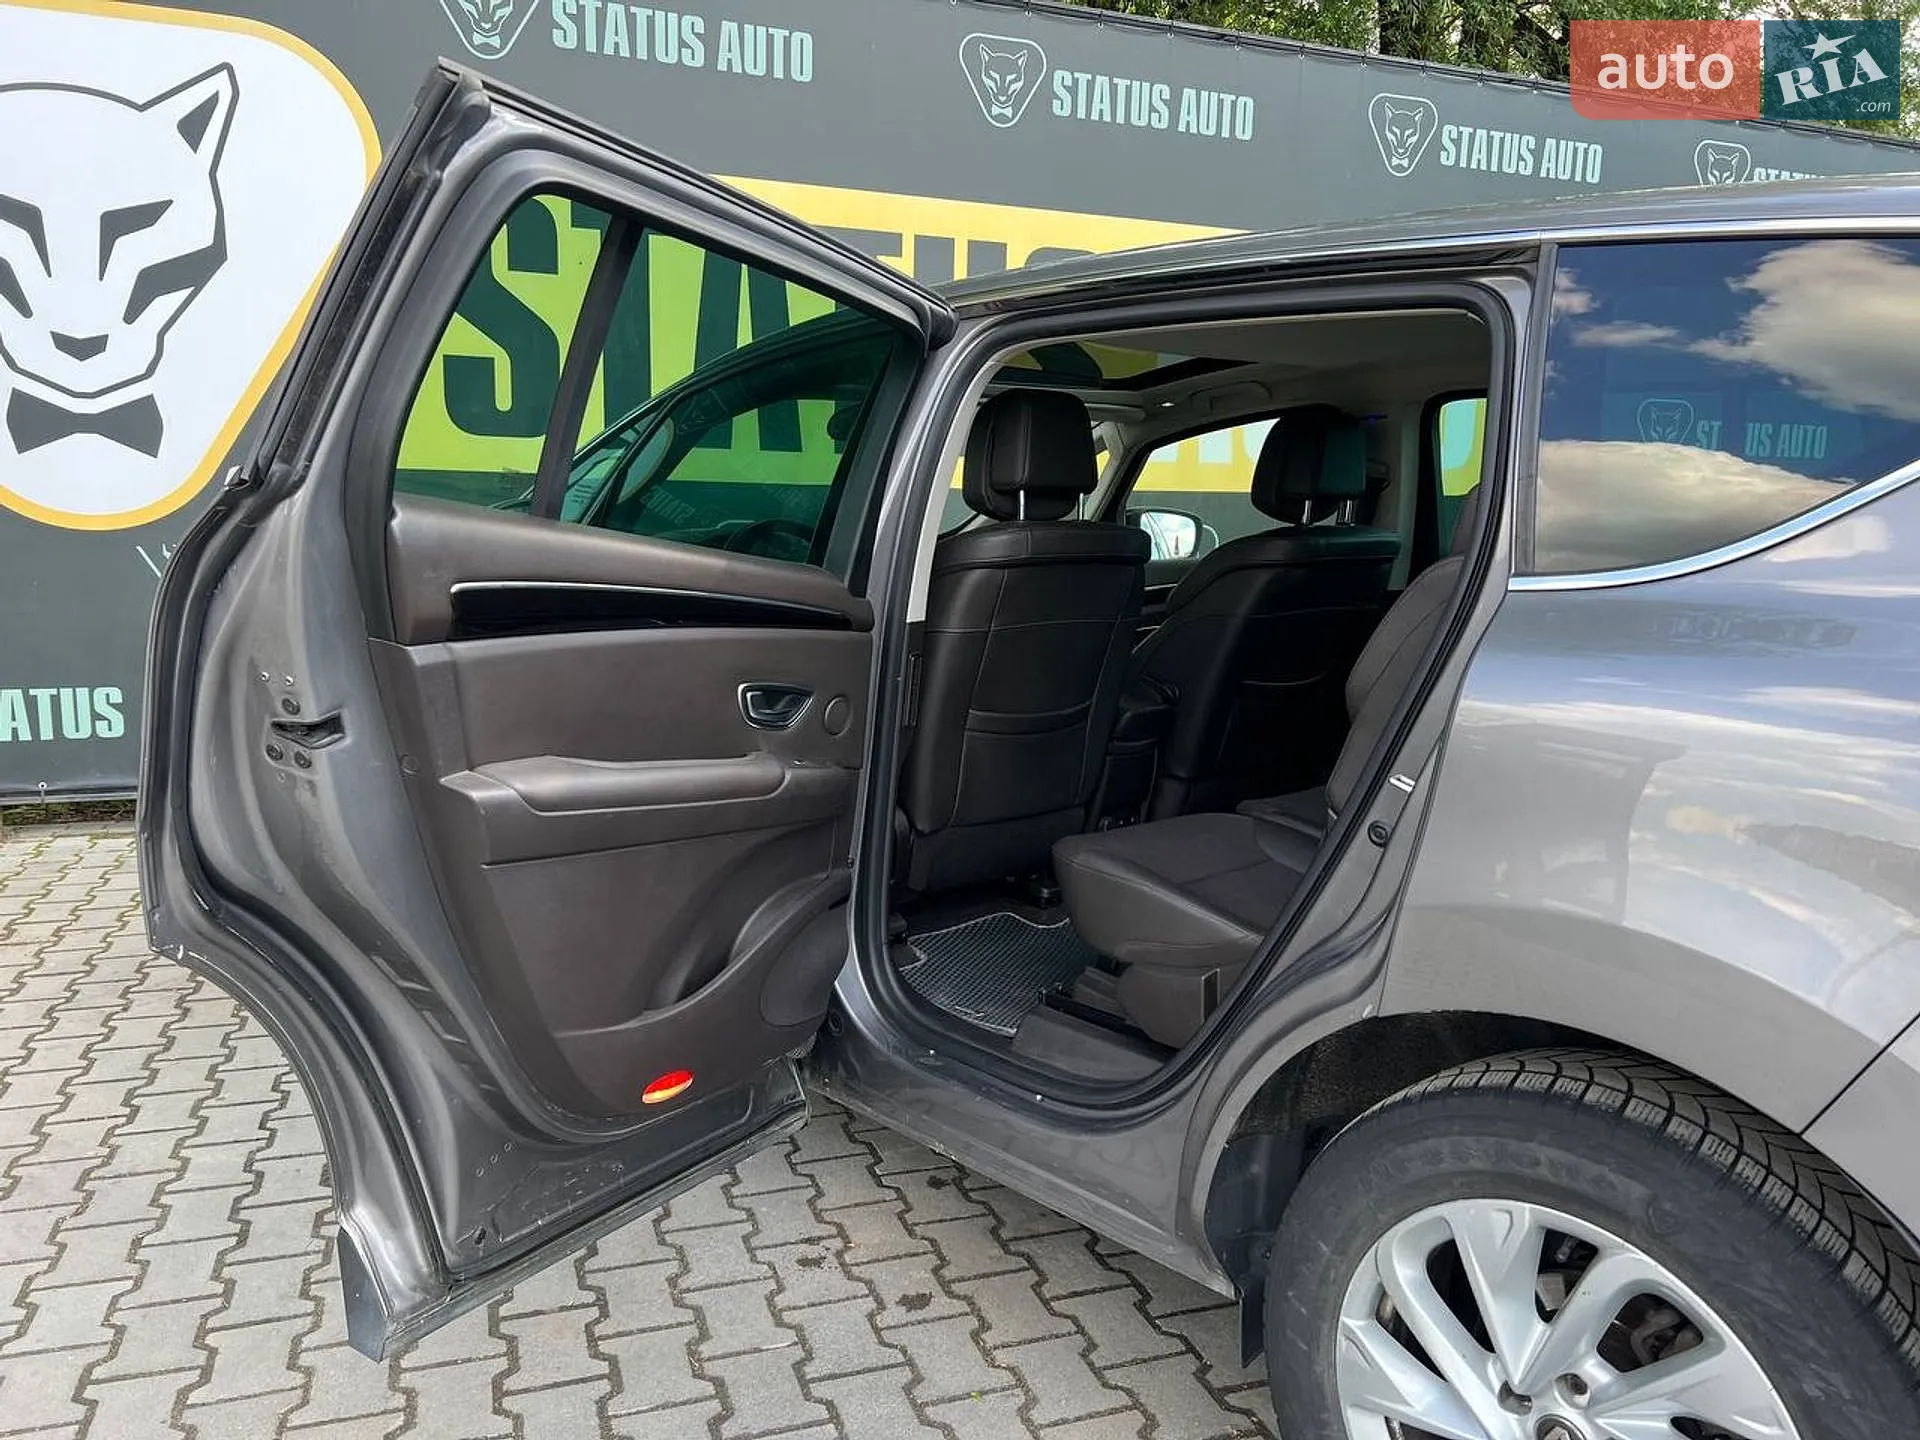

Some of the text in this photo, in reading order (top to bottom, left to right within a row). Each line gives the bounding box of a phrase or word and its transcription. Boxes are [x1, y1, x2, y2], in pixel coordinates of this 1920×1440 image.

[551, 0, 813, 83] STATUS AUTO
[1052, 69, 1254, 141] STATUS AUTO
[1440, 124, 1603, 184] STATUS AUTO
[1775, 423, 1827, 459] AUTO
